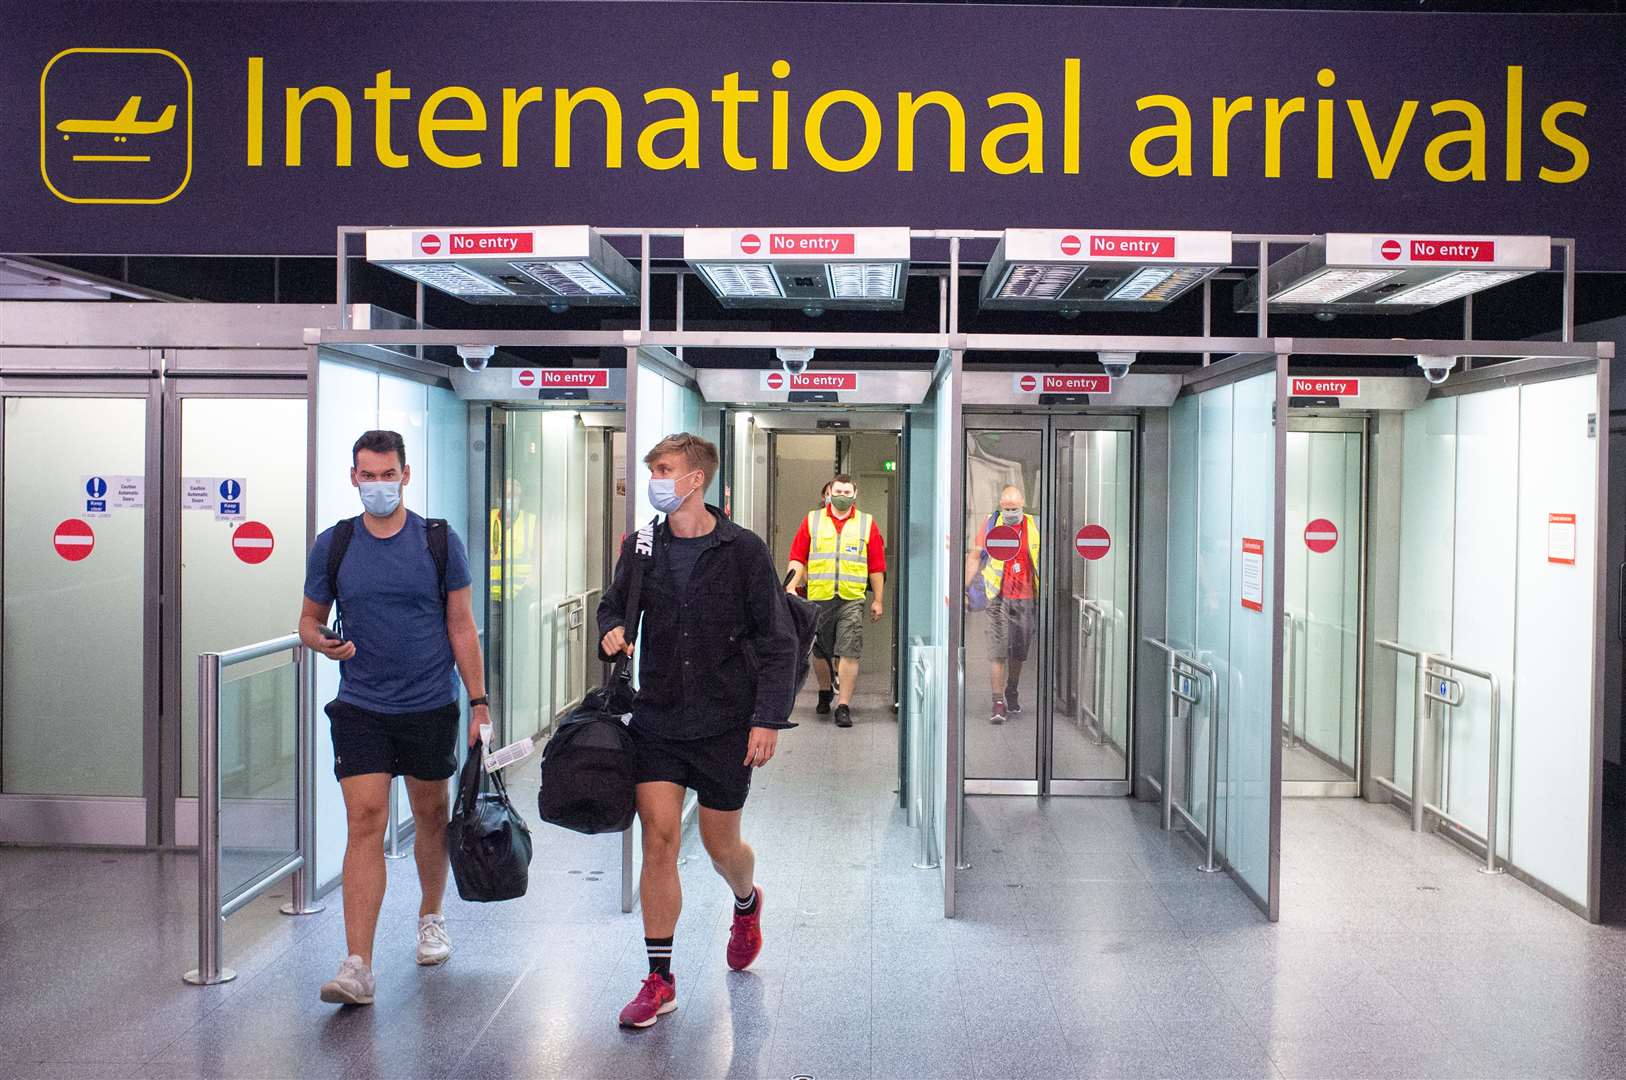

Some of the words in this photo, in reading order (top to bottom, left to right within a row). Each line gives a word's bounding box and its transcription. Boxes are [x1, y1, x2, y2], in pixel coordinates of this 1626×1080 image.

[247, 57, 1081, 175] International
[1129, 65, 1590, 184] arrivals
[455, 237, 473, 248] No
[479, 237, 518, 250] entry
[775, 236, 795, 248] No
[800, 237, 839, 251] entry
[1095, 238, 1115, 250] No
[1120, 240, 1159, 254] entry
[1415, 243, 1434, 255] No
[1440, 245, 1478, 258] entry
[545, 373, 561, 382] No
[565, 374, 595, 384] entry
[793, 375, 809, 384] No
[813, 376, 844, 387] entry
[1047, 378, 1062, 387] No
[1067, 379, 1097, 389] entry
[1296, 381, 1312, 390] No
[1316, 383, 1346, 393] entry
